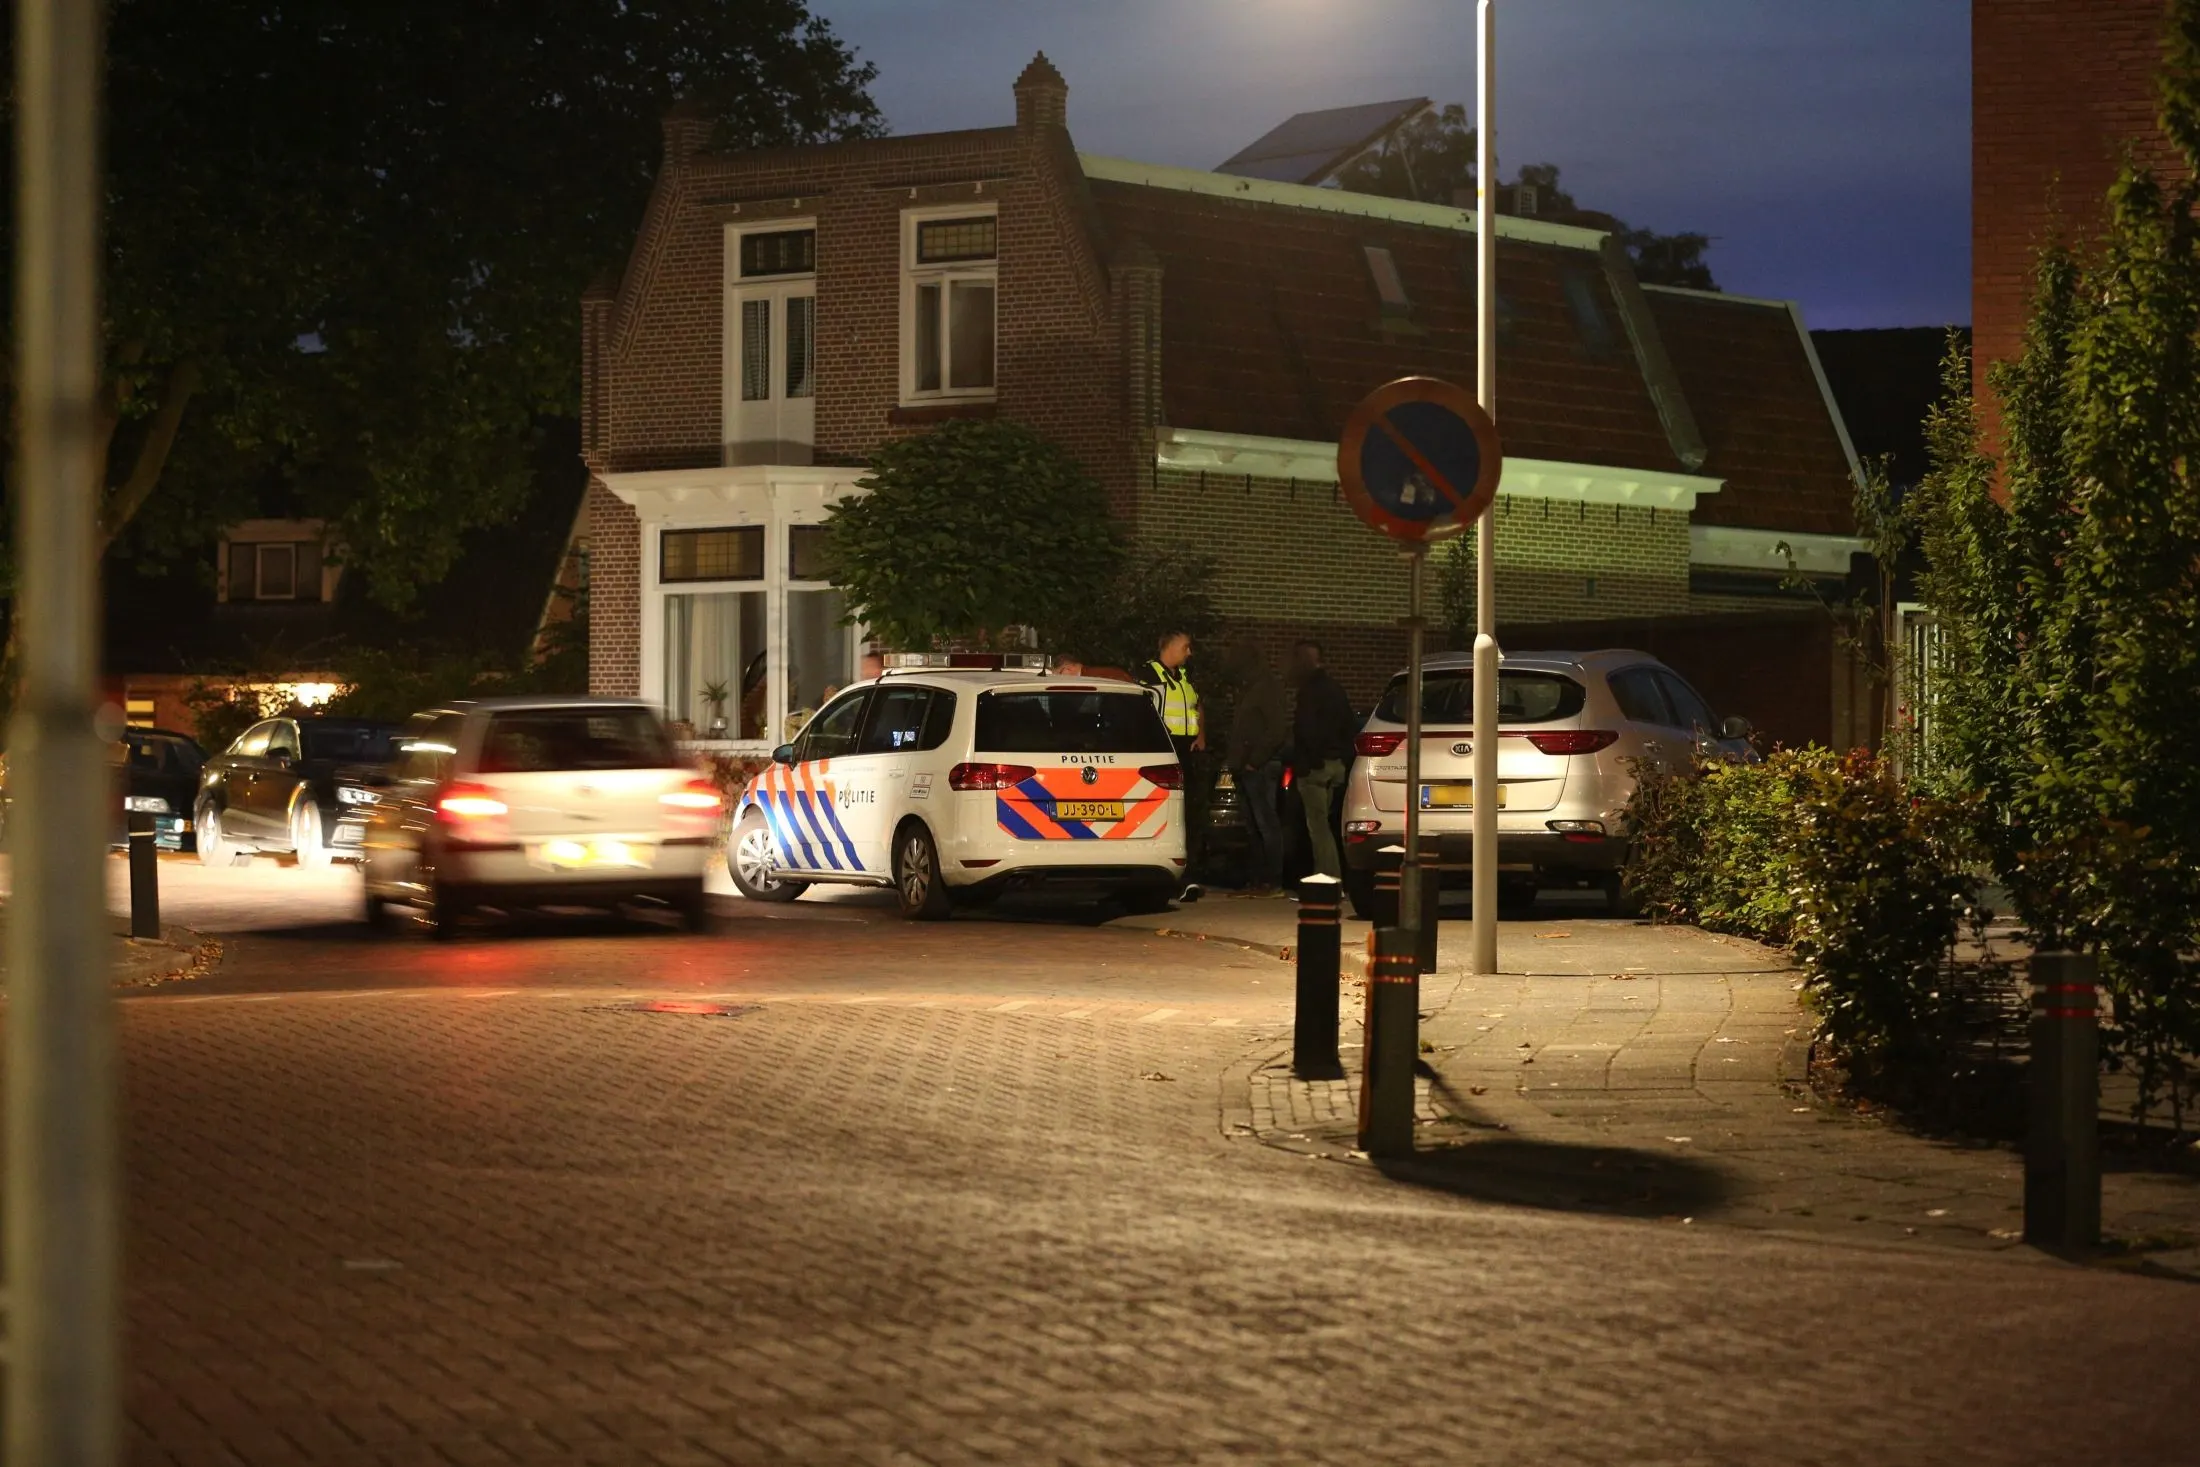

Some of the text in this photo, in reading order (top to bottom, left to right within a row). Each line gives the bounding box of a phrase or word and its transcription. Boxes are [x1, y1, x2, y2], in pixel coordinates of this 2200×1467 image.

[1061, 755, 1115, 764] POLITIE
[839, 788, 875, 808] POLITIE
[1063, 804, 1117, 816] JJ-390-L
